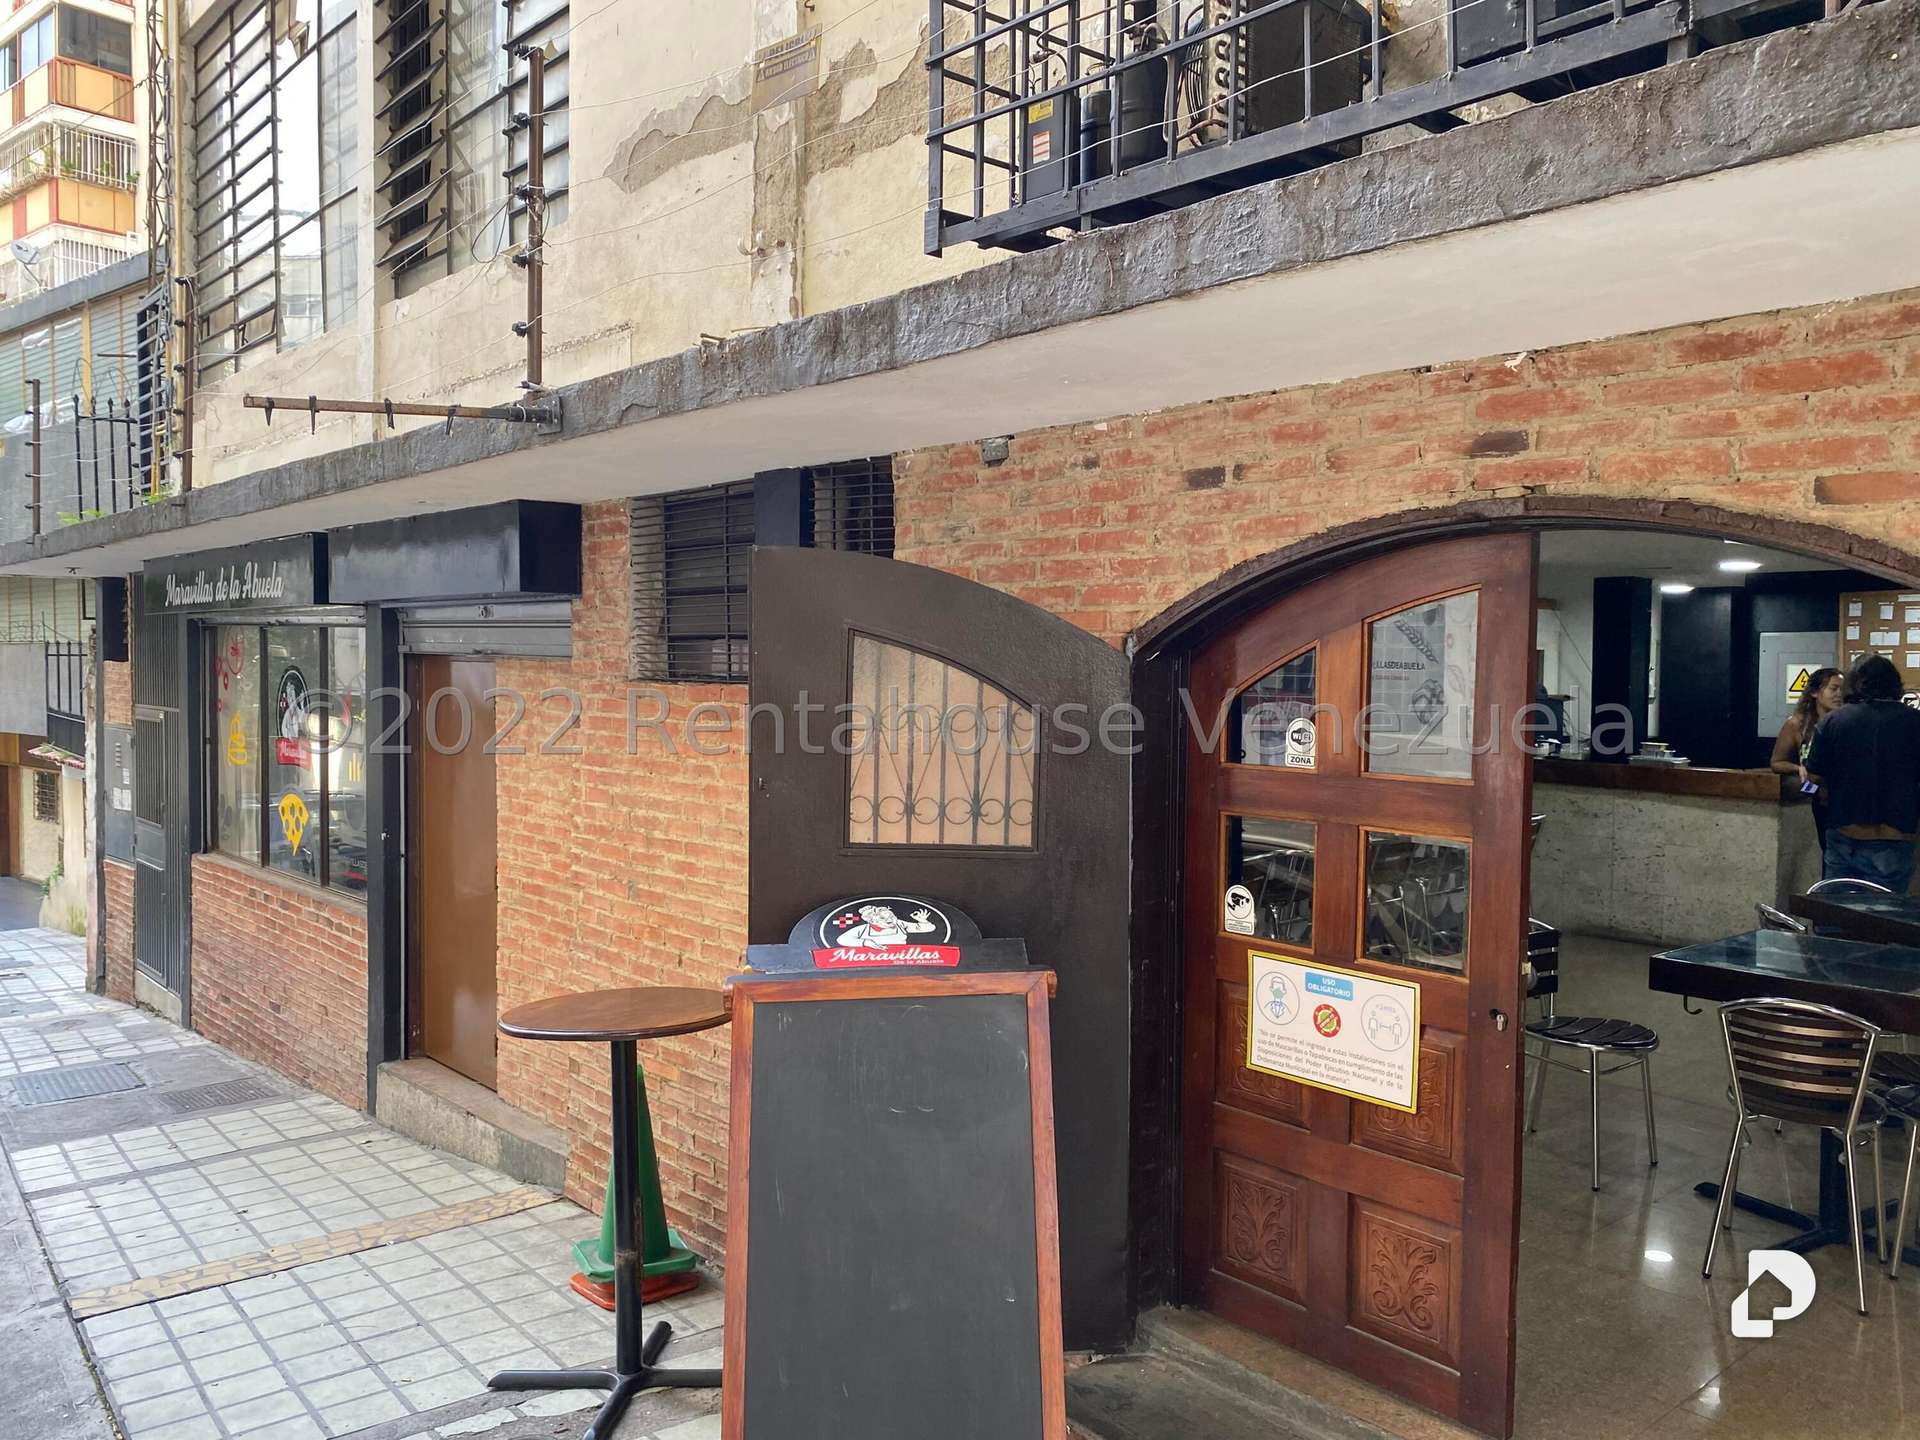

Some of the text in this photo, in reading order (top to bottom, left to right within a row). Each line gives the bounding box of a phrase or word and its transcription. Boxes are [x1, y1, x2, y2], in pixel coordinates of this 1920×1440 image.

[165, 561, 284, 607] Maravillas de la Abuela
[1290, 756, 1312, 765] ZONA
[829, 946, 940, 963] Maravillas
[1322, 976, 1336, 986] USO
[1307, 982, 1351, 997] OBLIGATORIO
